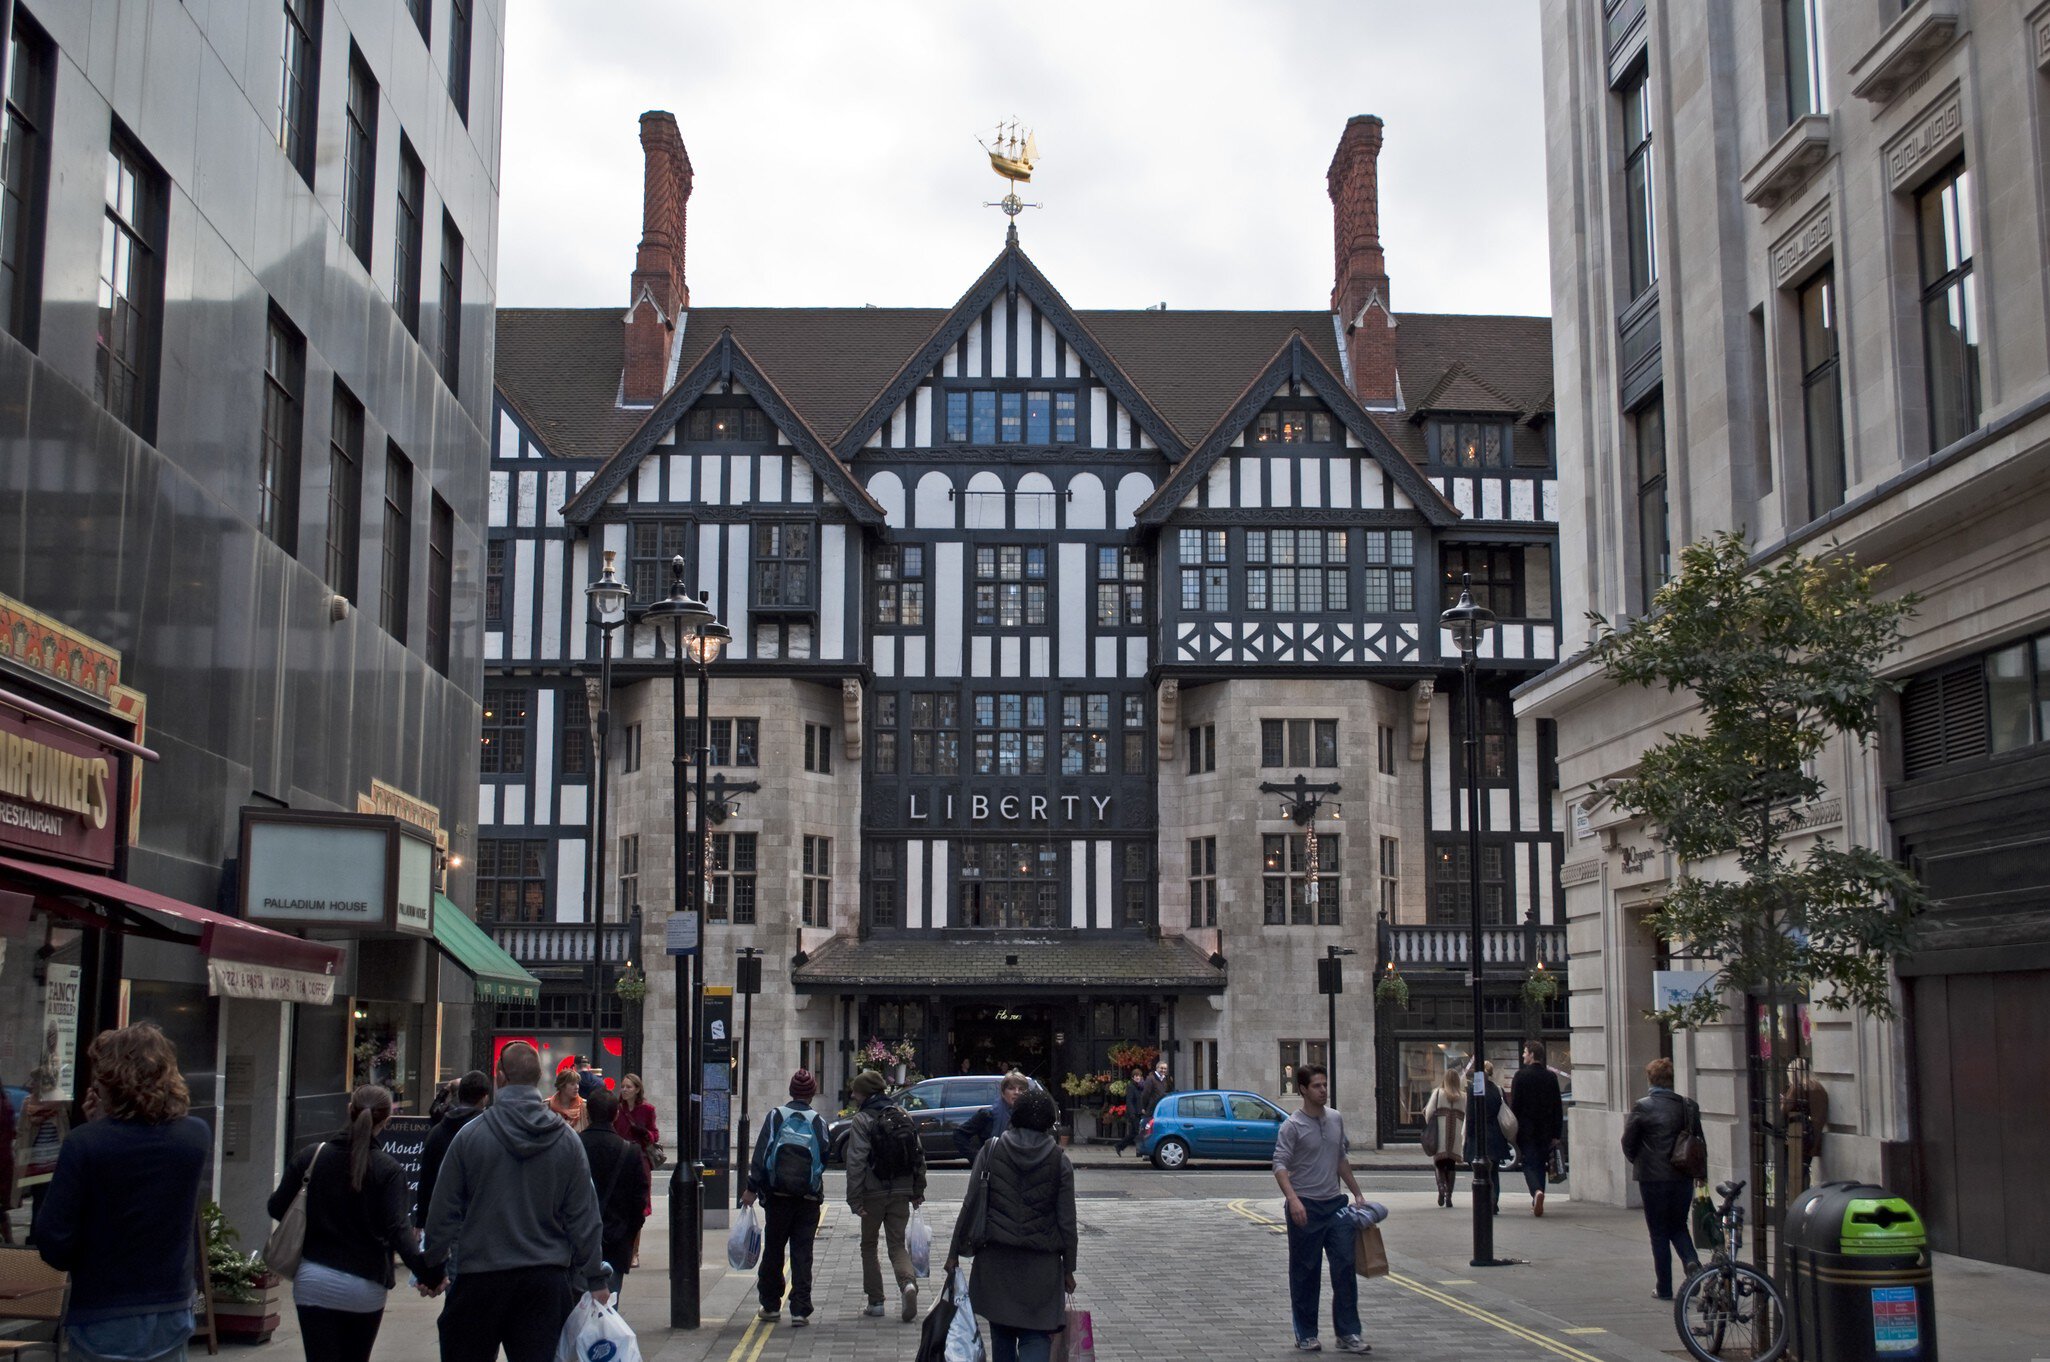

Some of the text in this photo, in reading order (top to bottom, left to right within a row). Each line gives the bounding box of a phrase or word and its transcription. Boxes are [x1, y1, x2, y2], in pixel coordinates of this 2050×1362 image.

[909, 794, 1112, 820] LIBERTY
[0, 803, 63, 836] RESTAURANT
[264, 898, 368, 912] PALLADIUM HOUSE
[48, 981, 78, 1002] FANCY
[410, 1123, 430, 1132] UNO
